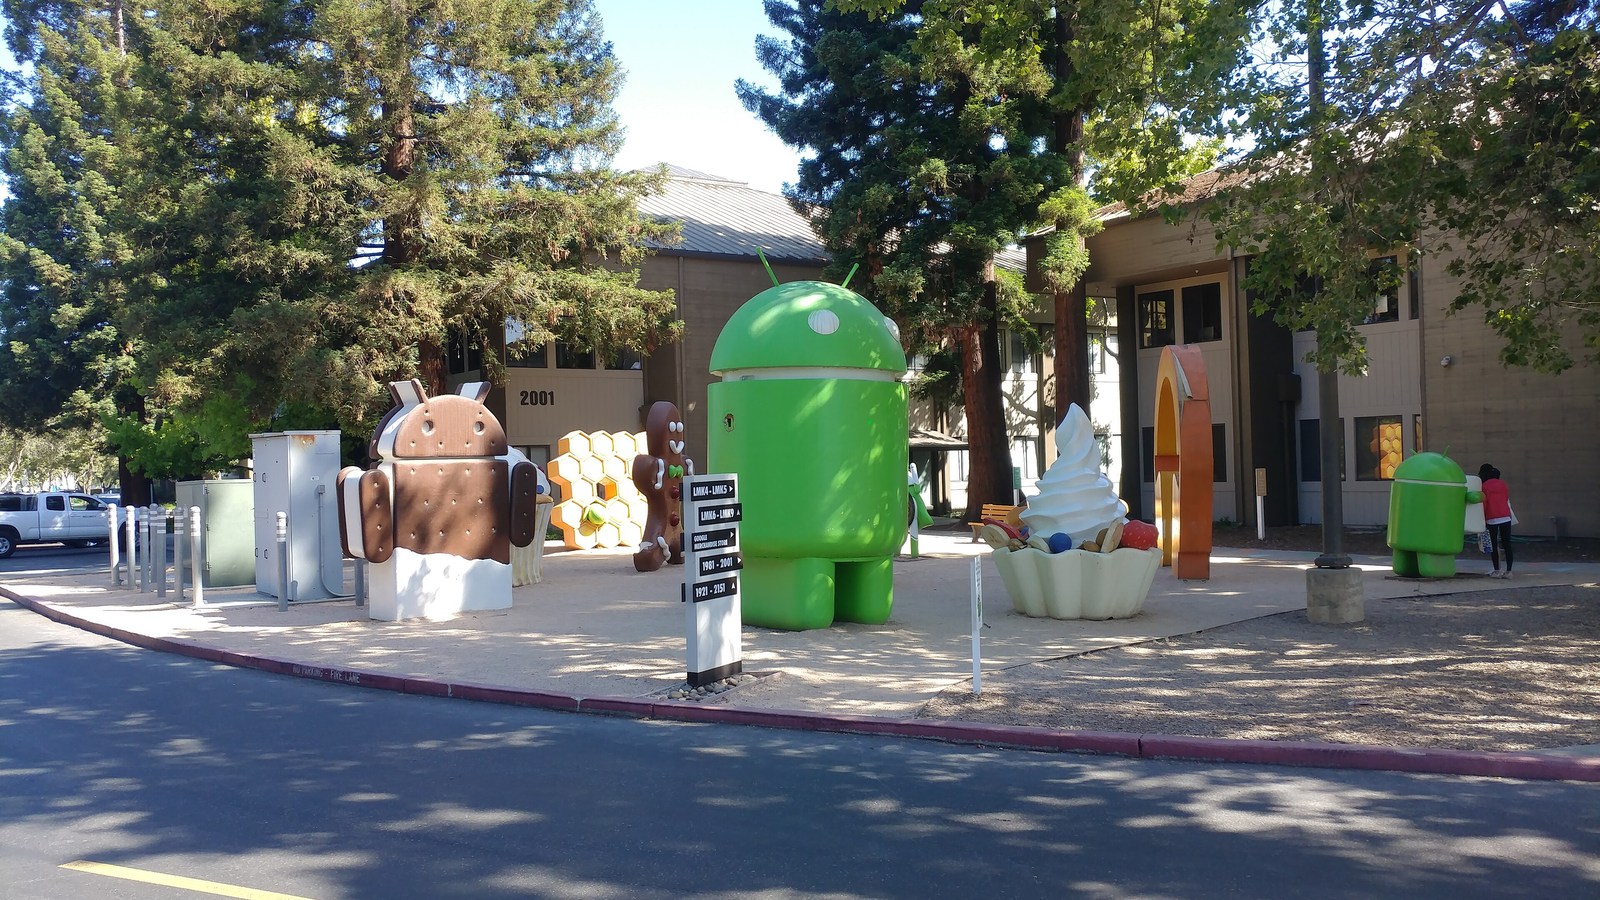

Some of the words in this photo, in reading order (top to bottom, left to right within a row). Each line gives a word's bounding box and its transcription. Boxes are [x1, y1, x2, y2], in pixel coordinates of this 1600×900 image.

[520, 390, 554, 405] 2001
[702, 560, 715, 571] 1981
[720, 557, 733, 568] 2001
[695, 586, 708, 598] 1921
[713, 583, 726, 594] 2151
